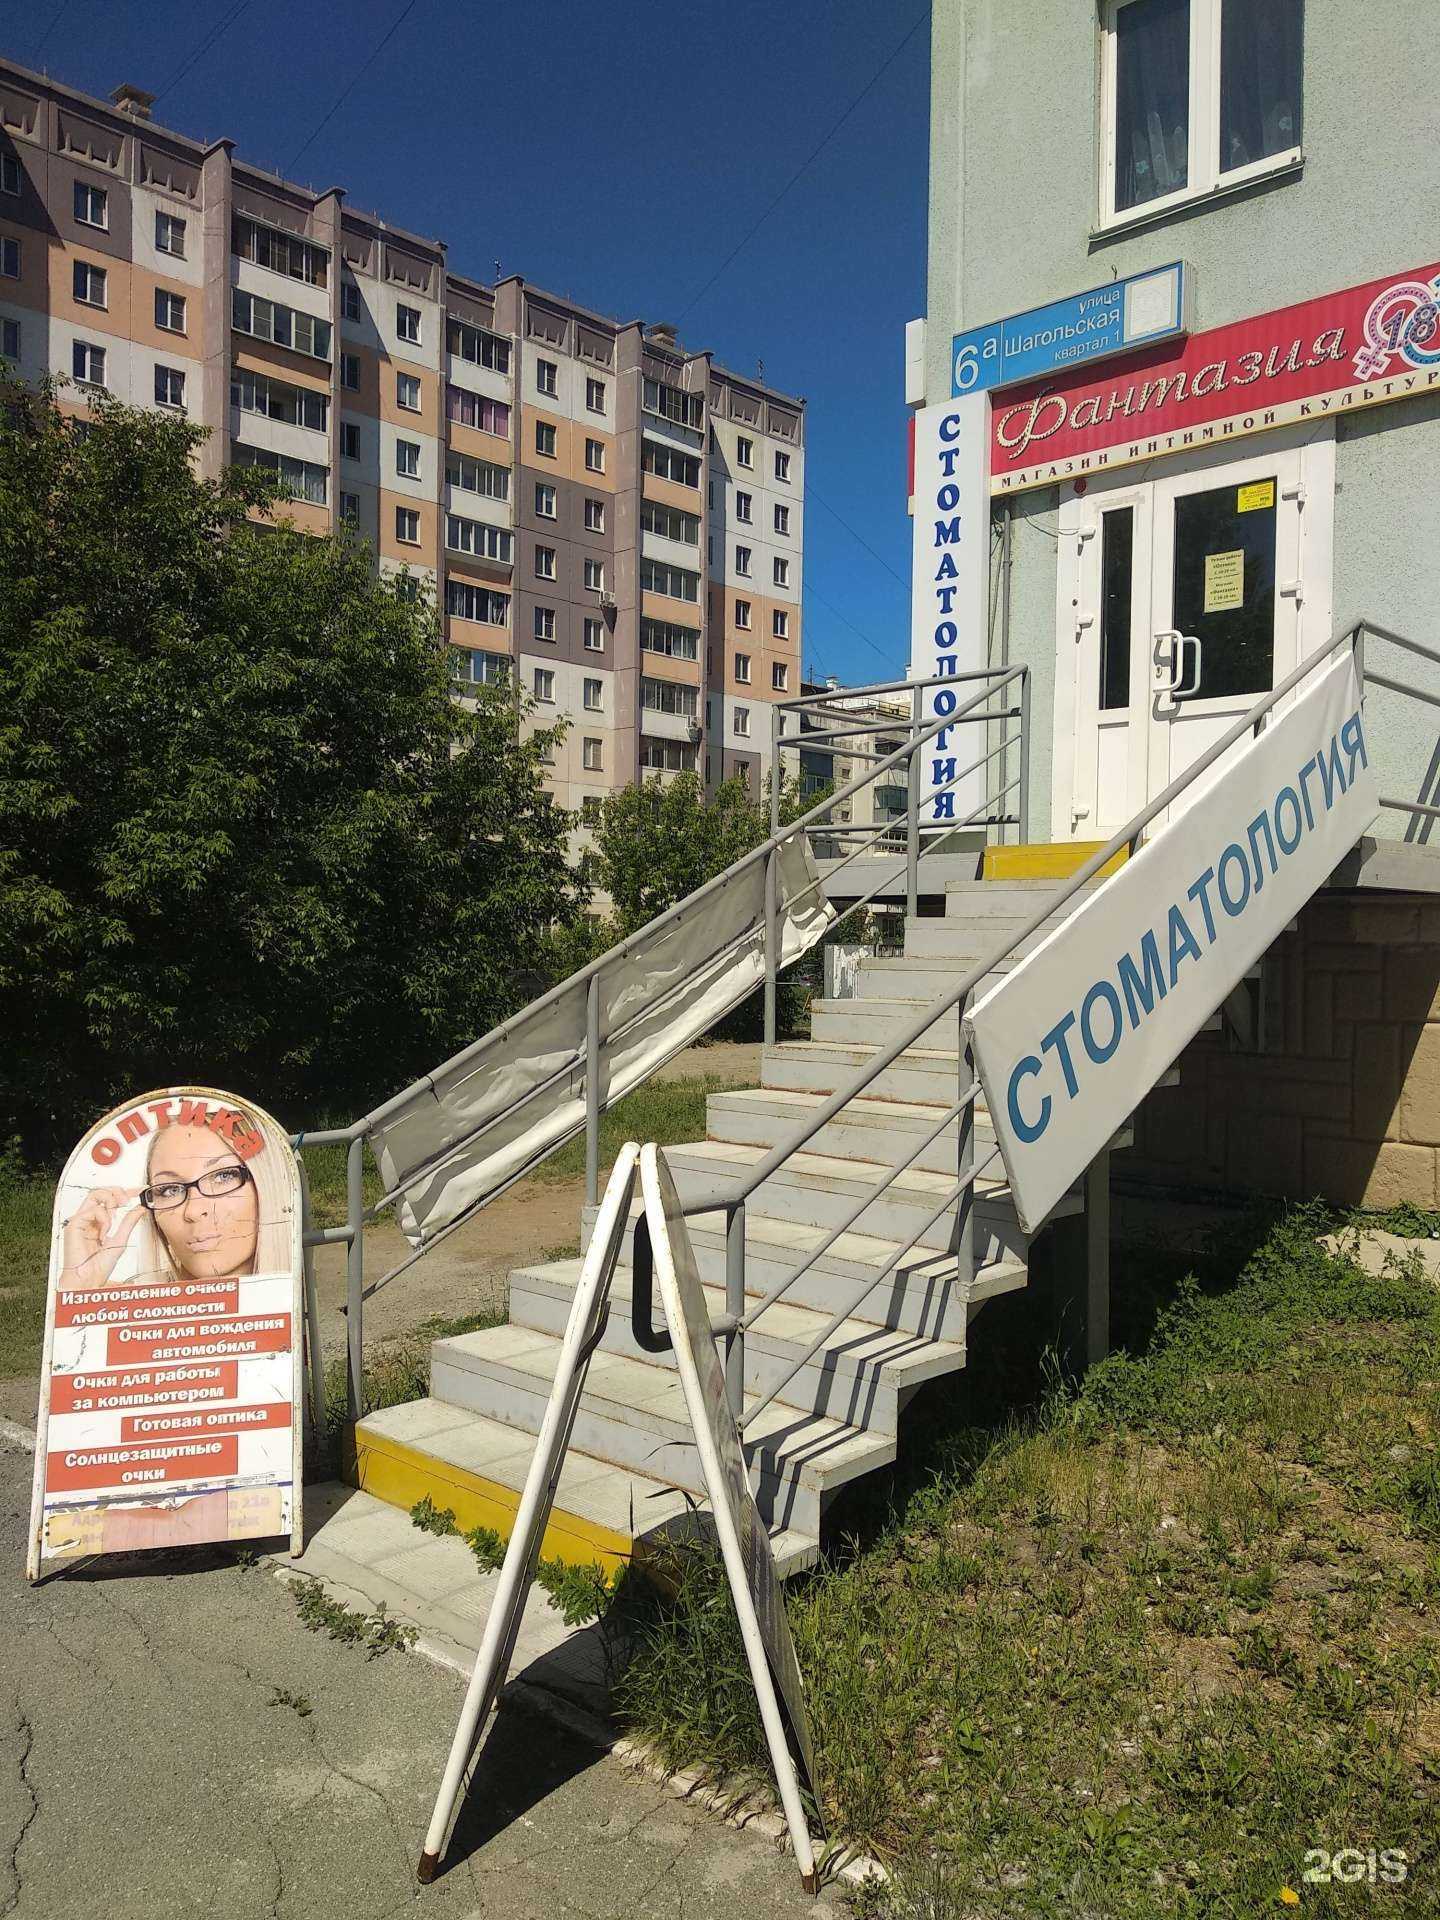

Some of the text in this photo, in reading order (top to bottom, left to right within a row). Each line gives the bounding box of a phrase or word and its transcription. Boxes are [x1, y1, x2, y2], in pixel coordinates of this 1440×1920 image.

[1079, 289, 1120, 315] улица
[1004, 308, 1120, 357] Шагольская
[1055, 329, 1120, 361] квартал 1
[997, 326, 1347, 459] Фантазия
[1001, 454, 1108, 488] МАГАЗИН
[1129, 409, 1276, 457] ИНТИМНОЙ
[932, 414, 960, 819] СТОМАТОЛОГИЯ
[1007, 711, 1368, 1143] СТОМАТОЛОГИЯ
[62, 1281, 237, 1306] Изготовление очков
[72, 1302, 225, 1324] любой сложности
[119, 1318, 285, 1342] Очки для вождения
[152, 1340, 256, 1360] автомобиля
[72, 1367, 221, 1390] Очки для работы
[72, 1386, 225, 1410] за компьютером
[133, 1409, 268, 1433] Готовая оптика
[65, 1441, 222, 1467] Солнцезащитные
[121, 1468, 166, 1484] очки
